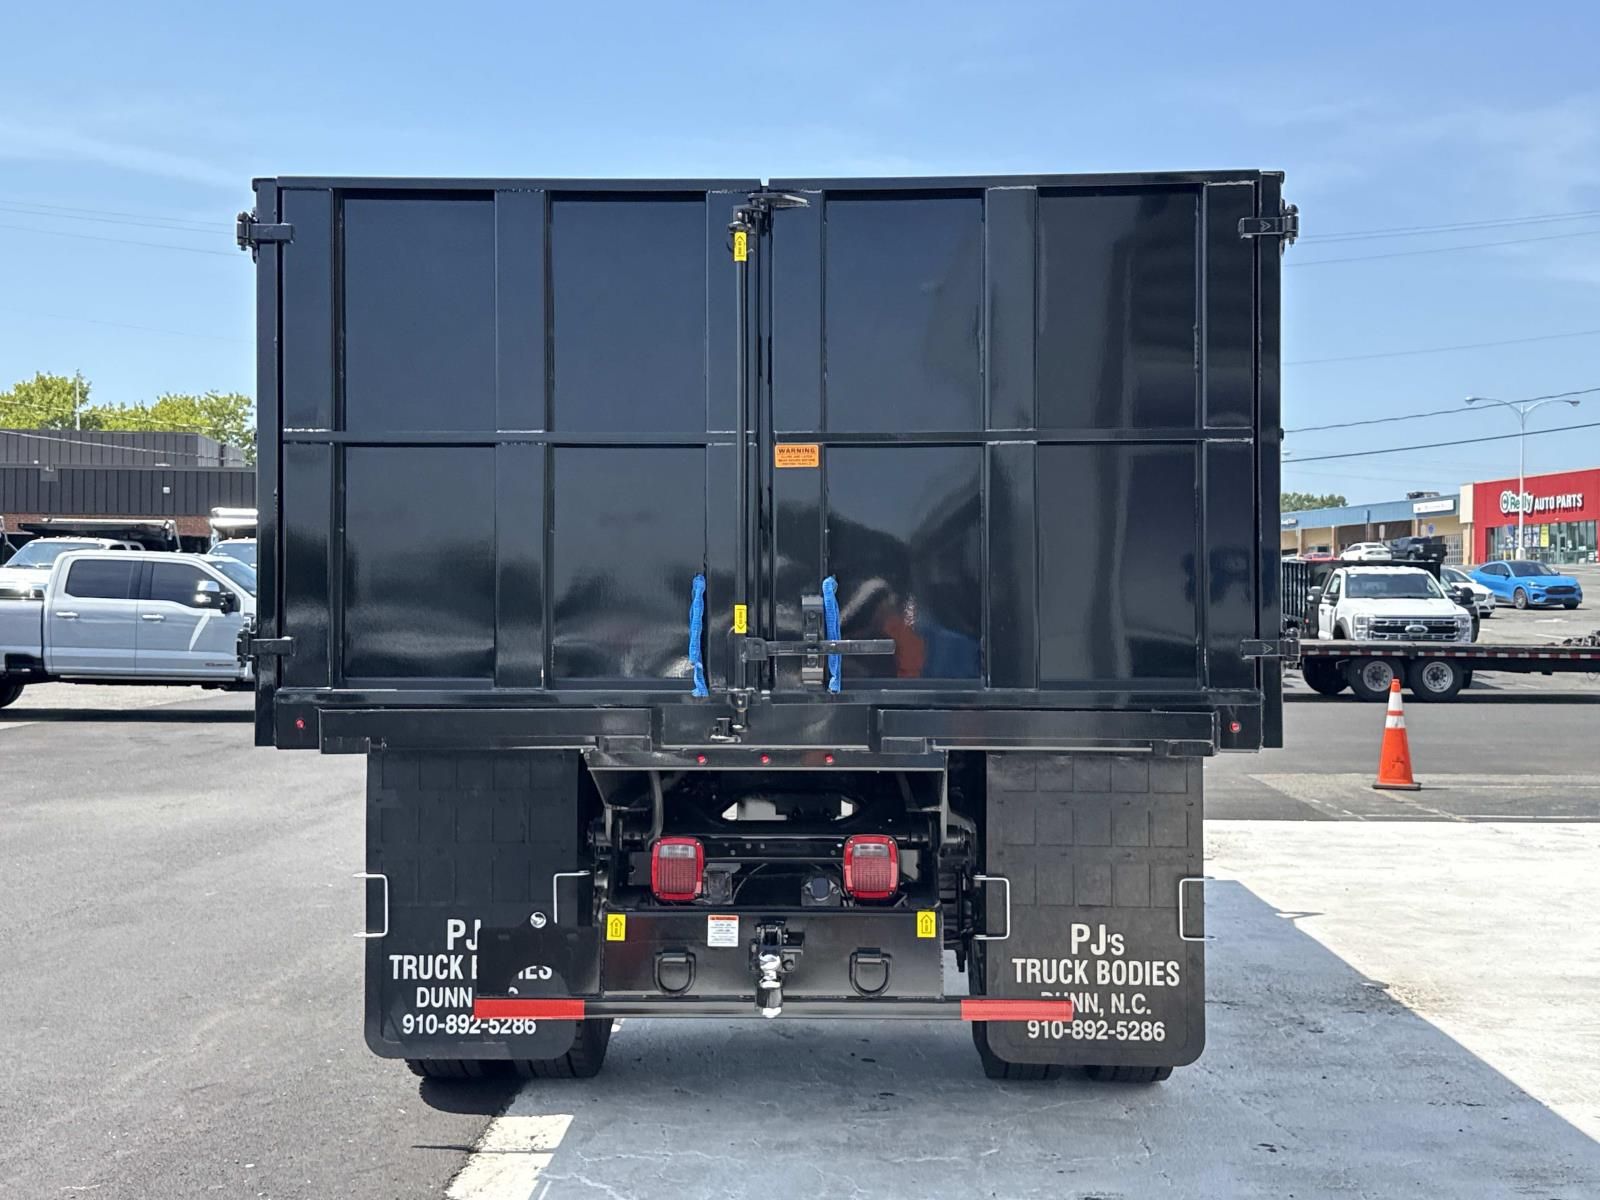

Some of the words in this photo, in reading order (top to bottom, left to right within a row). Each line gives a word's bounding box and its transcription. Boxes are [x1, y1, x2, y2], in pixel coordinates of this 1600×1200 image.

[1500, 491, 1534, 513] O'Relly
[1535, 497, 1555, 511] AUTO
[1556, 494, 1583, 509] PARTS
[1071, 923, 1125, 956] PJ's
[389, 954, 464, 980] TRUCK
[1012, 958, 1089, 984] TRUCK
[1096, 960, 1180, 986] BODIES
[1041, 991, 1105, 1017] NN,
[1111, 992, 1152, 1014] N.C.
[402, 1014, 537, 1035] 910-892-5286
[1027, 1020, 1166, 1042] 910-892-5286
